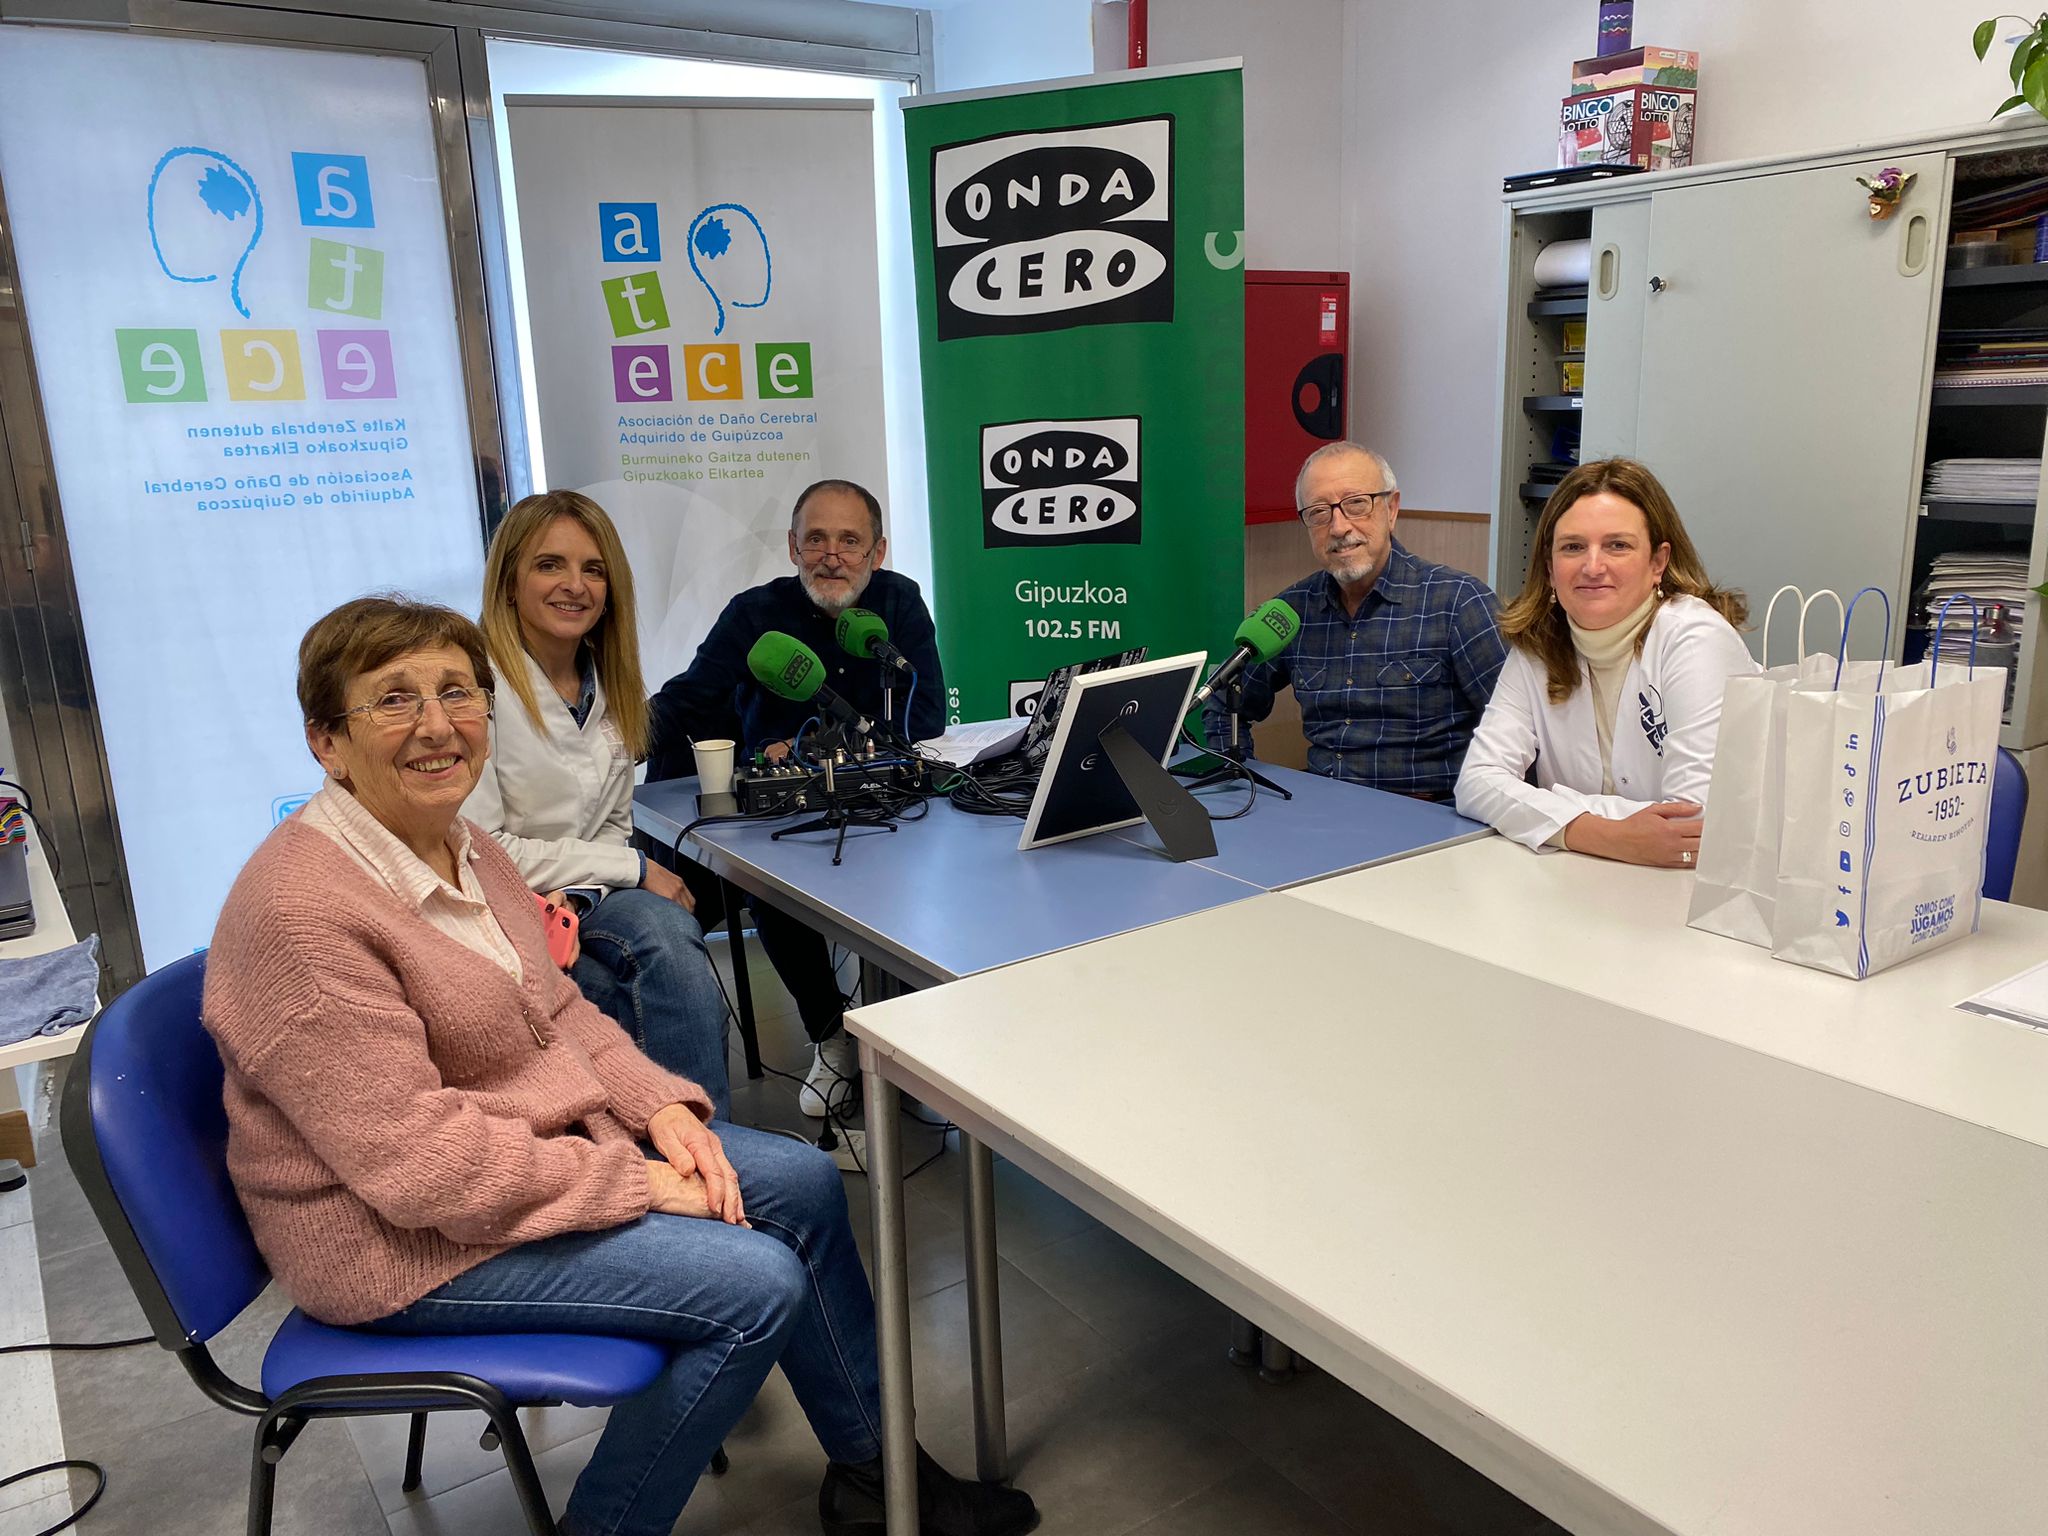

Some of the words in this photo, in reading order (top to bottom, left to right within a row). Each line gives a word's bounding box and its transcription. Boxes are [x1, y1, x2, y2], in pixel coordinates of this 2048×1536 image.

[1563, 98, 1613, 122] BINGO
[1640, 92, 1680, 111] BINGO
[1562, 119, 1598, 132] LOTTO
[1640, 111, 1669, 123] LOTTO
[964, 167, 1134, 221] ONDA
[976, 248, 1136, 301] CERO
[618, 414, 693, 427] Asociación
[698, 414, 714, 425] de
[720, 412, 755, 425] Daño
[760, 412, 818, 424] Cerebral
[619, 432, 685, 445] Adquirido
[690, 431, 707, 443] de
[712, 430, 783, 443] Guipúzcoa
[621, 453, 703, 466] Burmuineko
[708, 451, 751, 463] Gaitza
[756, 451, 810, 462] dutenen
[1003, 446, 1114, 474] ONDA
[623, 468, 704, 484] Gipuzkoako
[709, 467, 764, 479] Elkartea
[1011, 495, 1115, 524] CERO
[1015, 580, 1128, 608] Gipuzkoa
[1025, 619, 1082, 639] 102.5
[1088, 620, 1121, 640] FM
[1897, 762, 1987, 803] ZUBIETA
[1915, 900, 1938, 917] SOMOS
[1910, 906, 1954, 934] JUGAMOS
